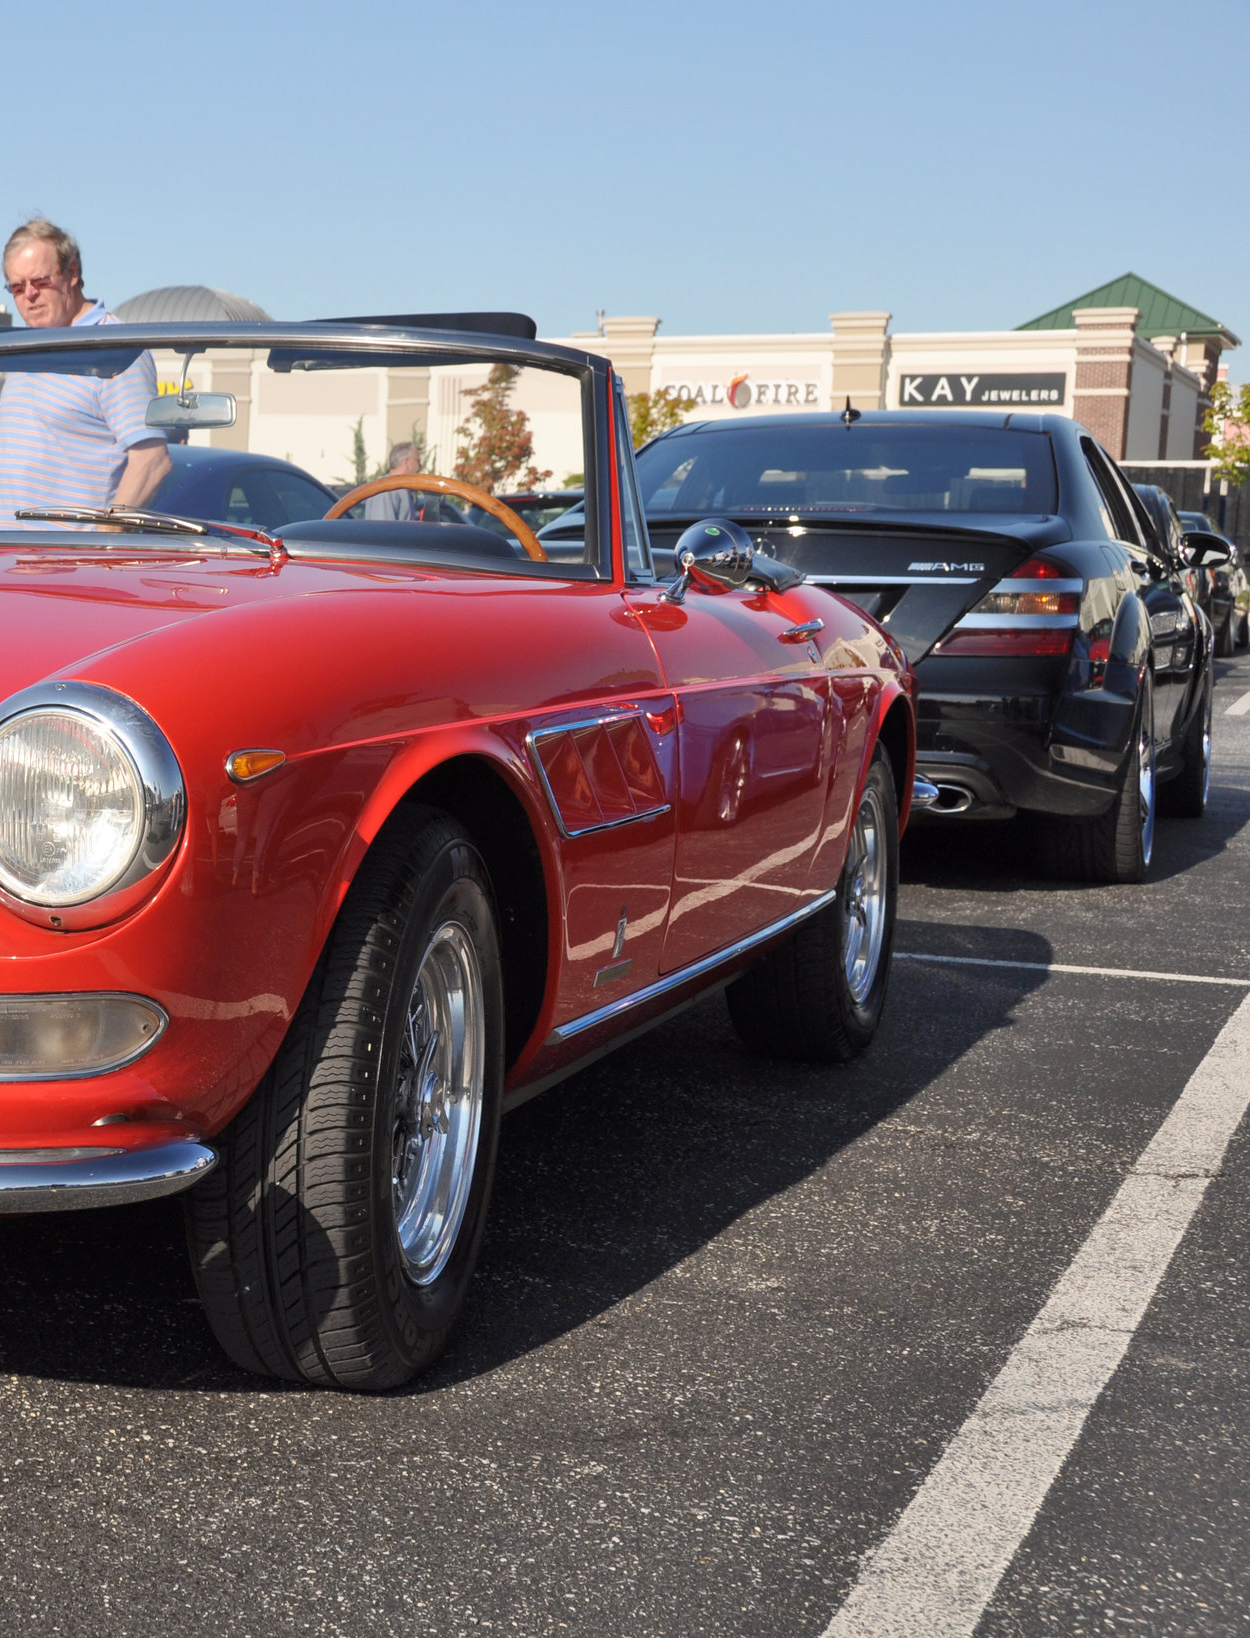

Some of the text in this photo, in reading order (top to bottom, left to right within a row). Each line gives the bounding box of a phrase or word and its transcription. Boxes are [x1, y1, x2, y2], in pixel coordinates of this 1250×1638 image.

[755, 383, 818, 404] FIRE
[903, 376, 1059, 402] KAY JEWELERS
[930, 562, 985, 571] AMG
